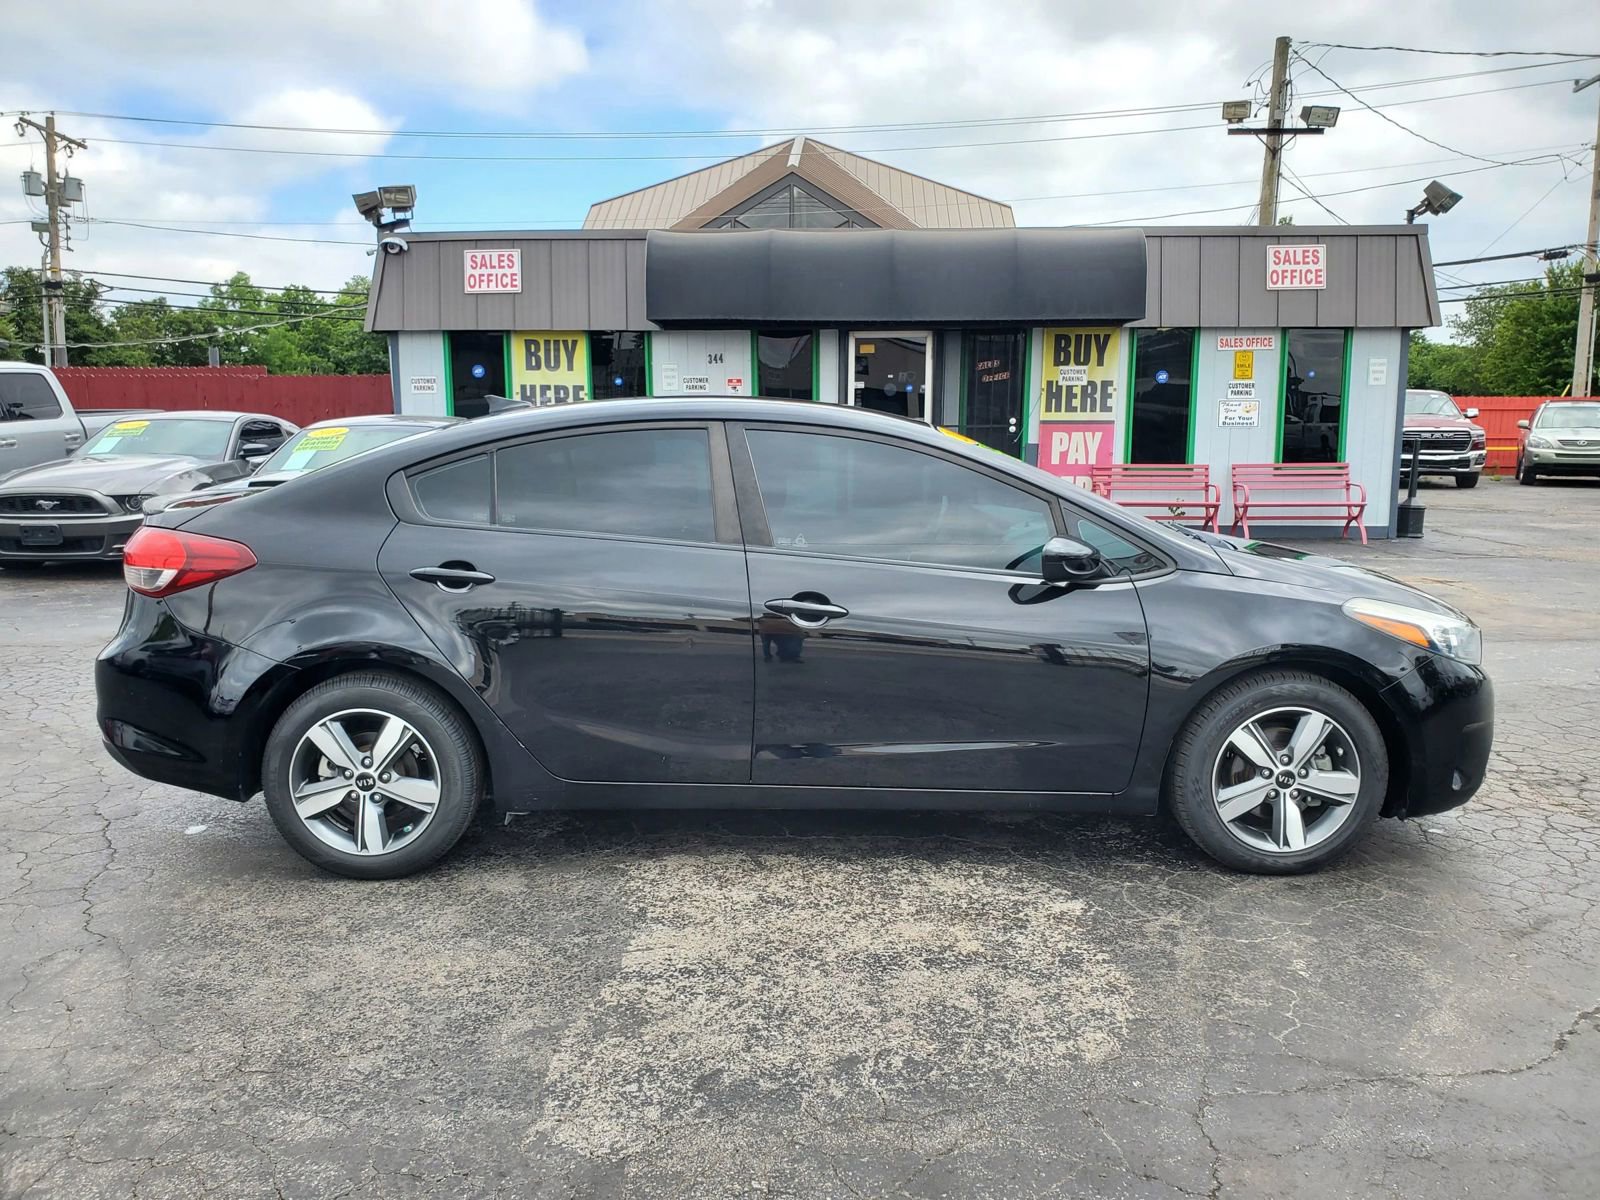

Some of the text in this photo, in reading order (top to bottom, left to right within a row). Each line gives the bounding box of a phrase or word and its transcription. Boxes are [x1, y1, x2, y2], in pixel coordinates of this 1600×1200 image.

[470, 254, 515, 270] SALES
[1273, 249, 1320, 265] SALES
[468, 273, 518, 289] OFFICE
[1270, 269, 1323, 285] OFFICE
[1053, 334, 1112, 367] BUY
[1219, 337, 1273, 348] SALES OFFICE
[524, 339, 579, 372] BUY
[708, 353, 724, 364] 344
[1045, 380, 1114, 413] HERE
[1051, 432, 1103, 465] PAY
[356, 777, 374, 787] KIA
[1278, 774, 1295, 785] KIA
